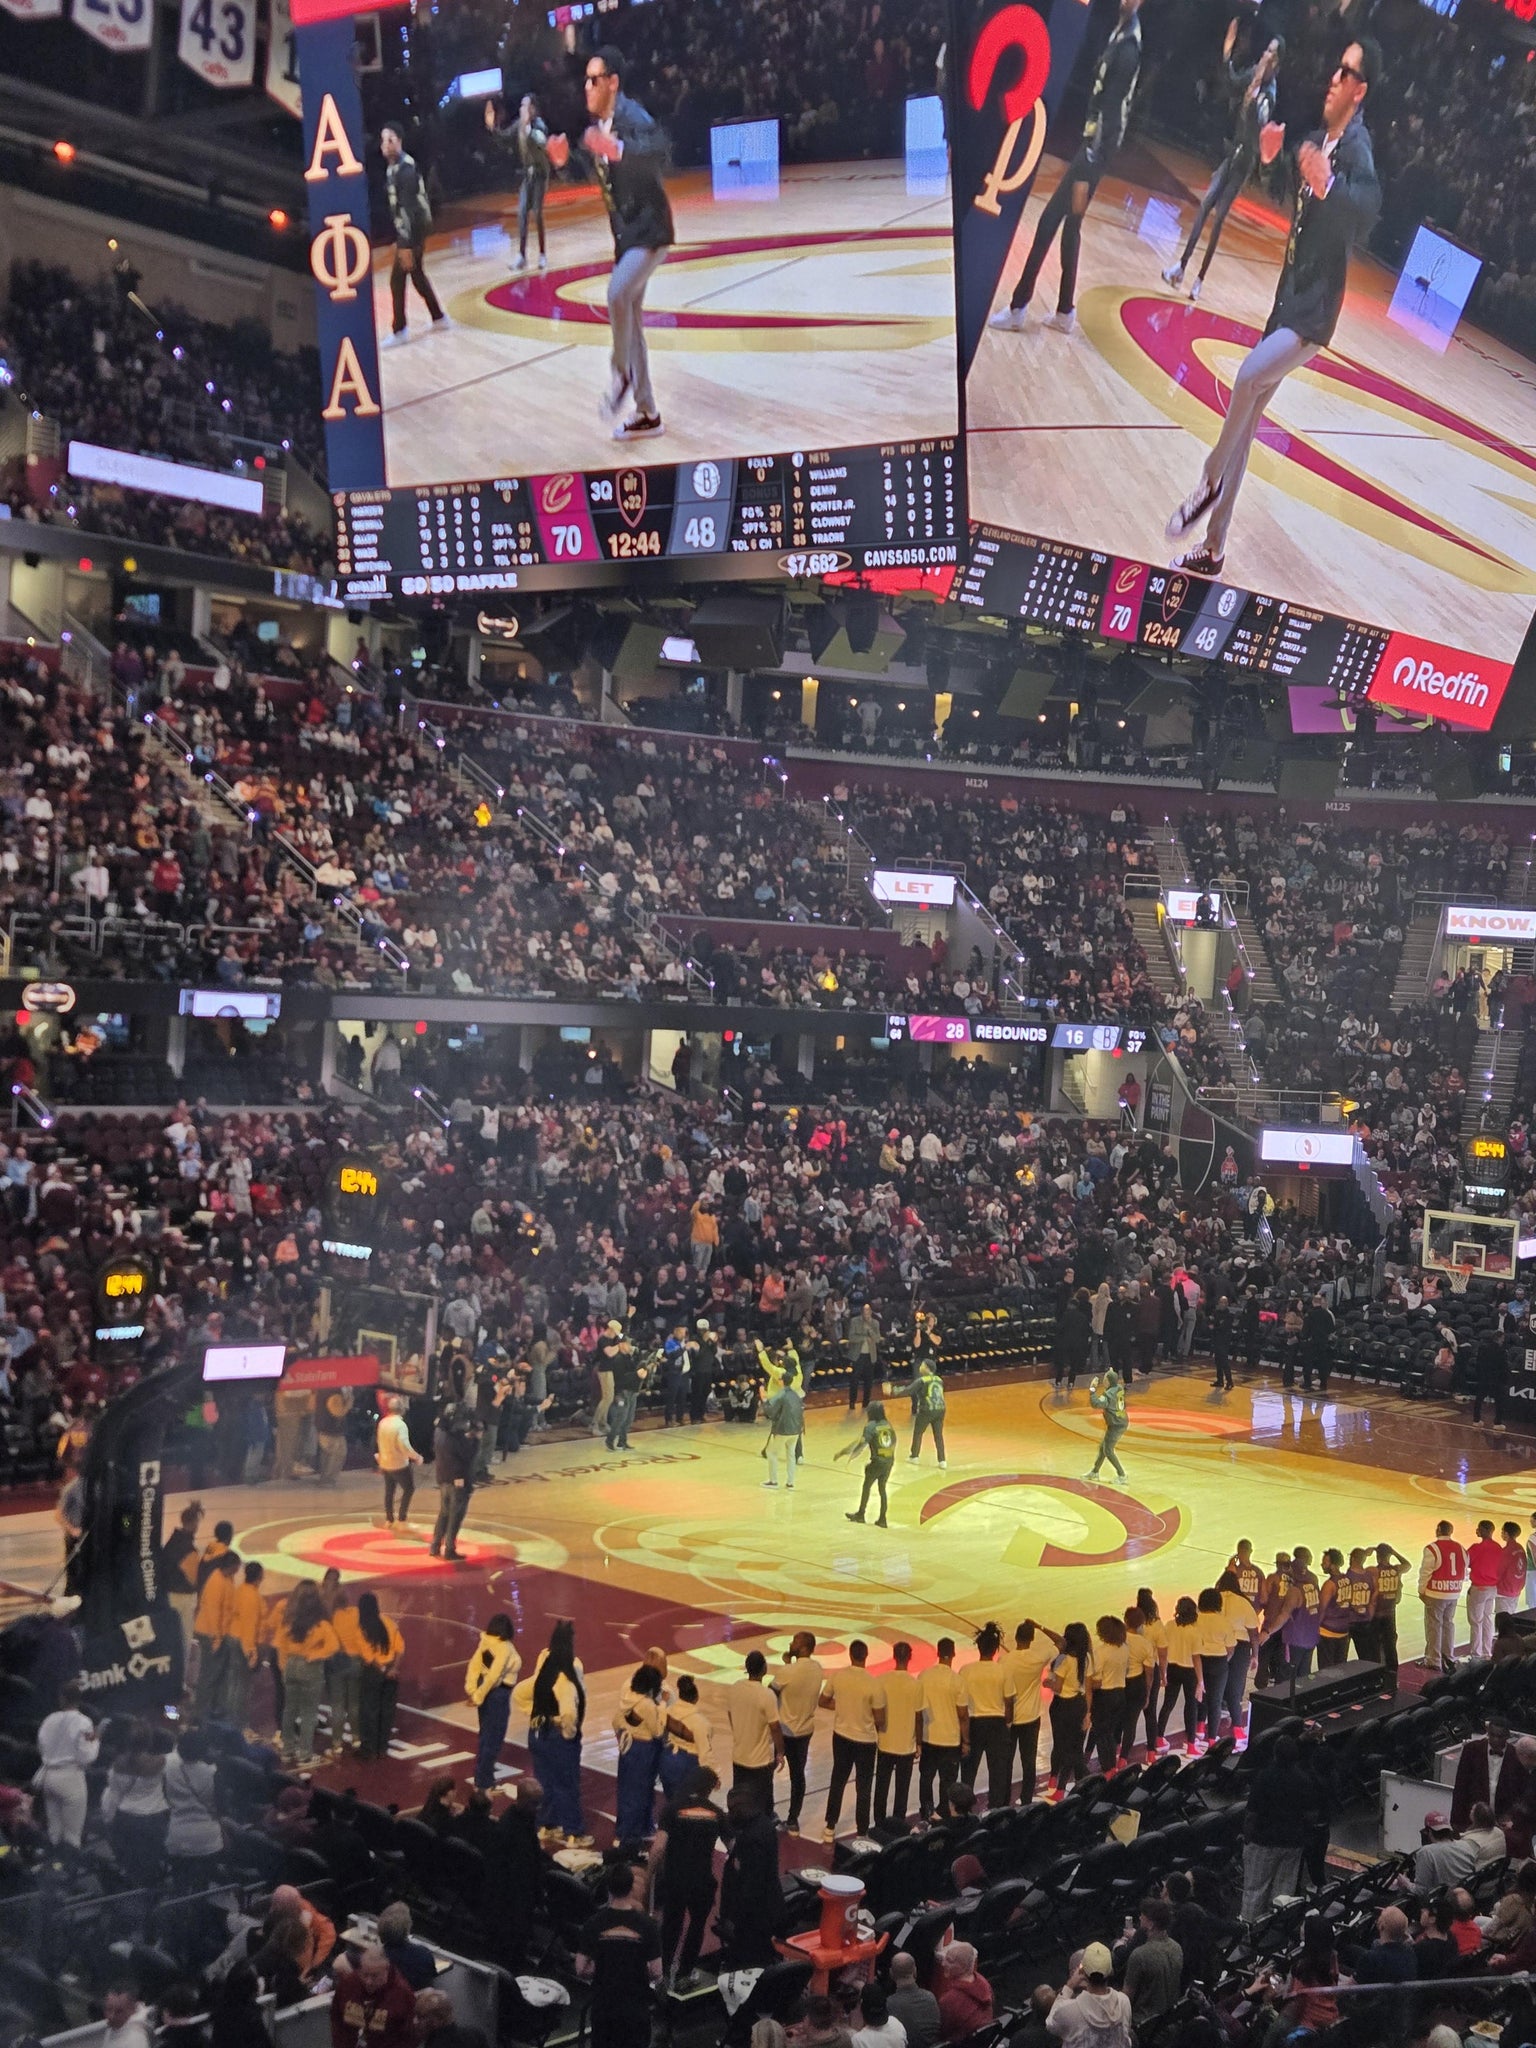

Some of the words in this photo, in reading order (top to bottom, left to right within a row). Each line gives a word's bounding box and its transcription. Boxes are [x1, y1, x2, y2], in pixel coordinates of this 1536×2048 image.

[190, 0, 245, 61] 43
[809, 467, 847, 480] WILLIAMS
[905, 460, 912, 472] 1
[923, 458, 929, 470] 1
[944, 456, 952, 468] 0
[591, 480, 612, 501] 3Q
[906, 476, 912, 489] 1
[924, 475, 932, 487] 0
[811, 500, 842, 512] PORTER
[908, 509, 915, 521] 0
[551, 525, 582, 555] 70
[685, 517, 715, 548] 48
[908, 526, 914, 538] 1
[608, 531, 660, 557] 12:44
[787, 553, 838, 578] $7,682
[864, 545, 957, 567] CAVS5050.COM
[456, 573, 517, 591] RAFFLE
[1149, 577, 1165, 594] 3Q
[1109, 604, 1131, 631] 70
[1144, 622, 1180, 648] 12:44
[1195, 627, 1217, 651] 48
[1413, 661, 1489, 707] Redfin
[965, 778, 988, 789] M124
[1325, 802, 1351, 812] M125
[894, 881, 934, 894] LET
[1449, 914, 1534, 931] KNOW.
[945, 1023, 965, 1039] 28
[976, 1025, 1047, 1042] REBOUNDS
[1066, 1030, 1083, 1045] 16
[1127, 1041, 1142, 1053] 37
[140, 1487, 156, 1559] Cleveland
[1450, 1552, 1456, 1576] 1
[140, 1560, 157, 1602] Clinic
